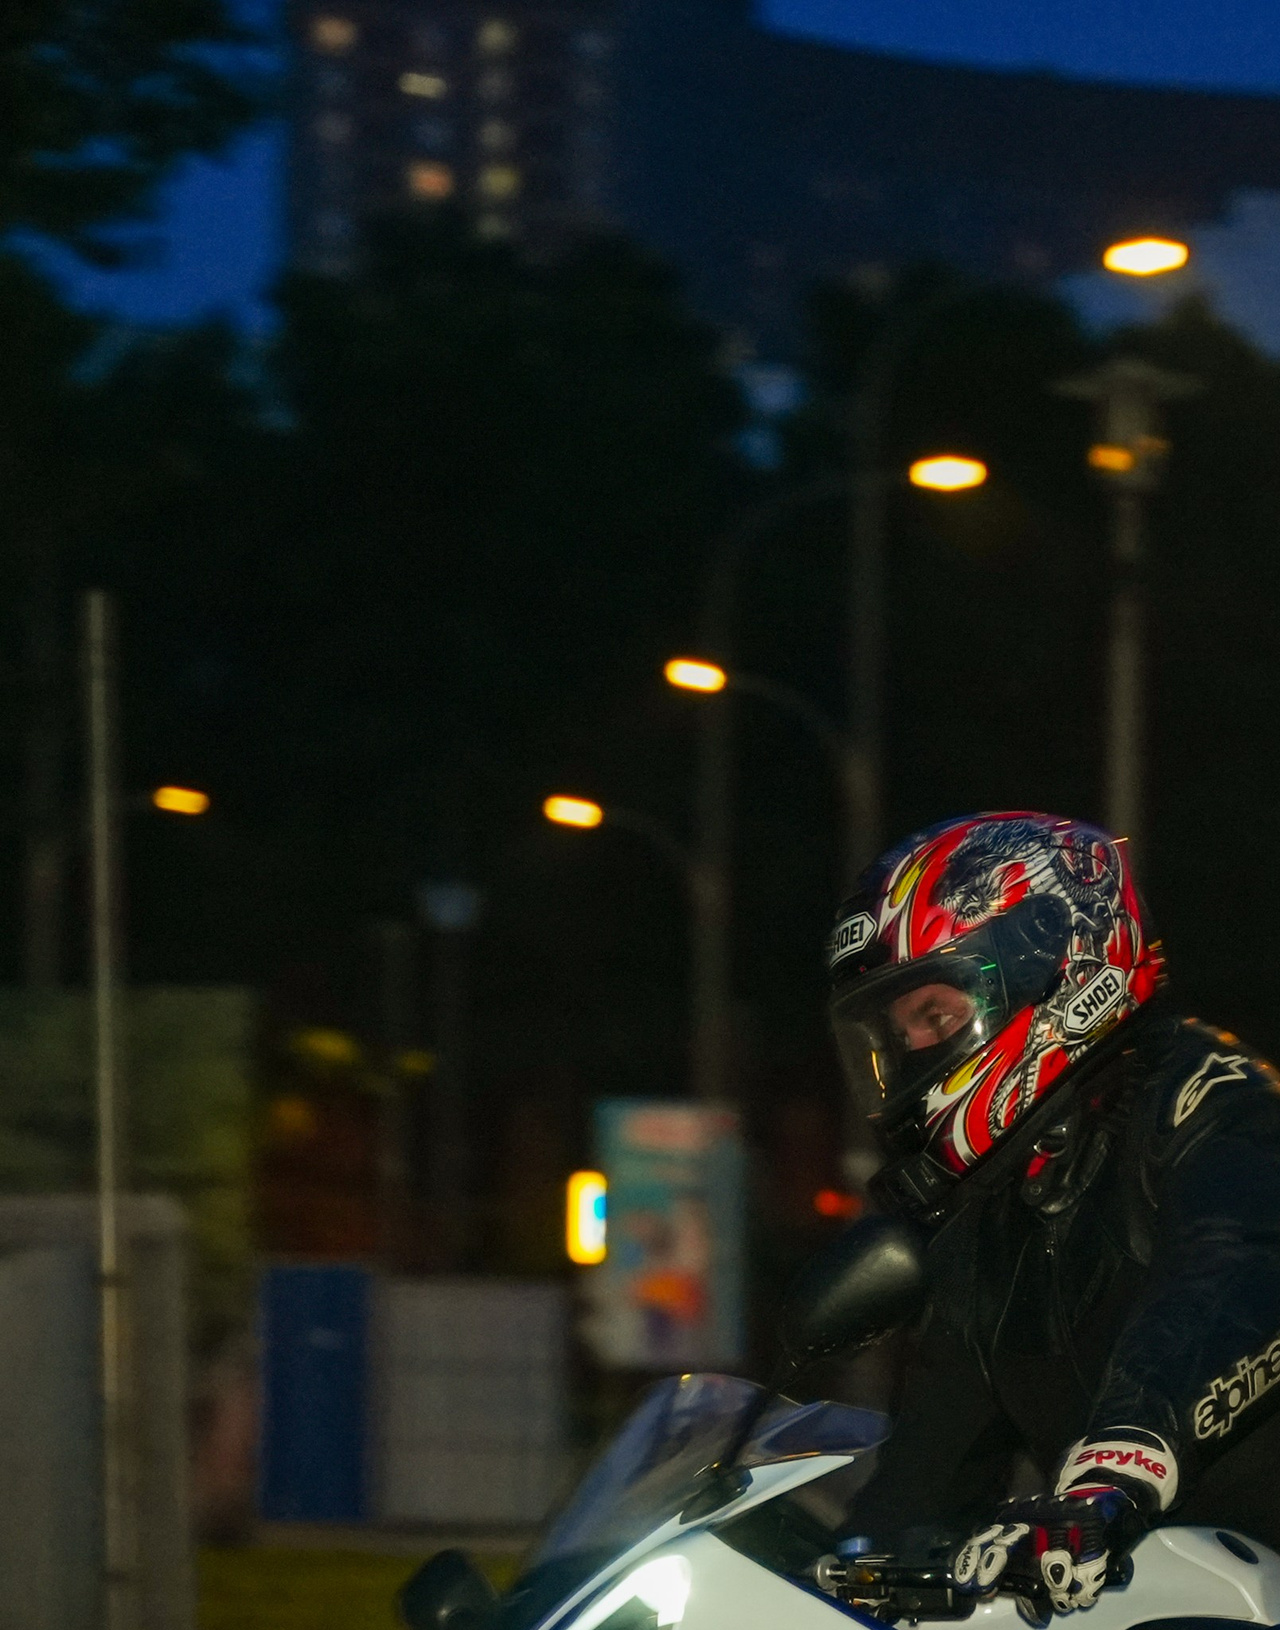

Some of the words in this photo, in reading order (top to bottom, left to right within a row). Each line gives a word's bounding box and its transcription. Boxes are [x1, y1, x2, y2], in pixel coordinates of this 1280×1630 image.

[834, 920, 864, 953] HOEI
[1072, 972, 1120, 1025] SHOEI
[1074, 1450, 1167, 1480] Spyke
